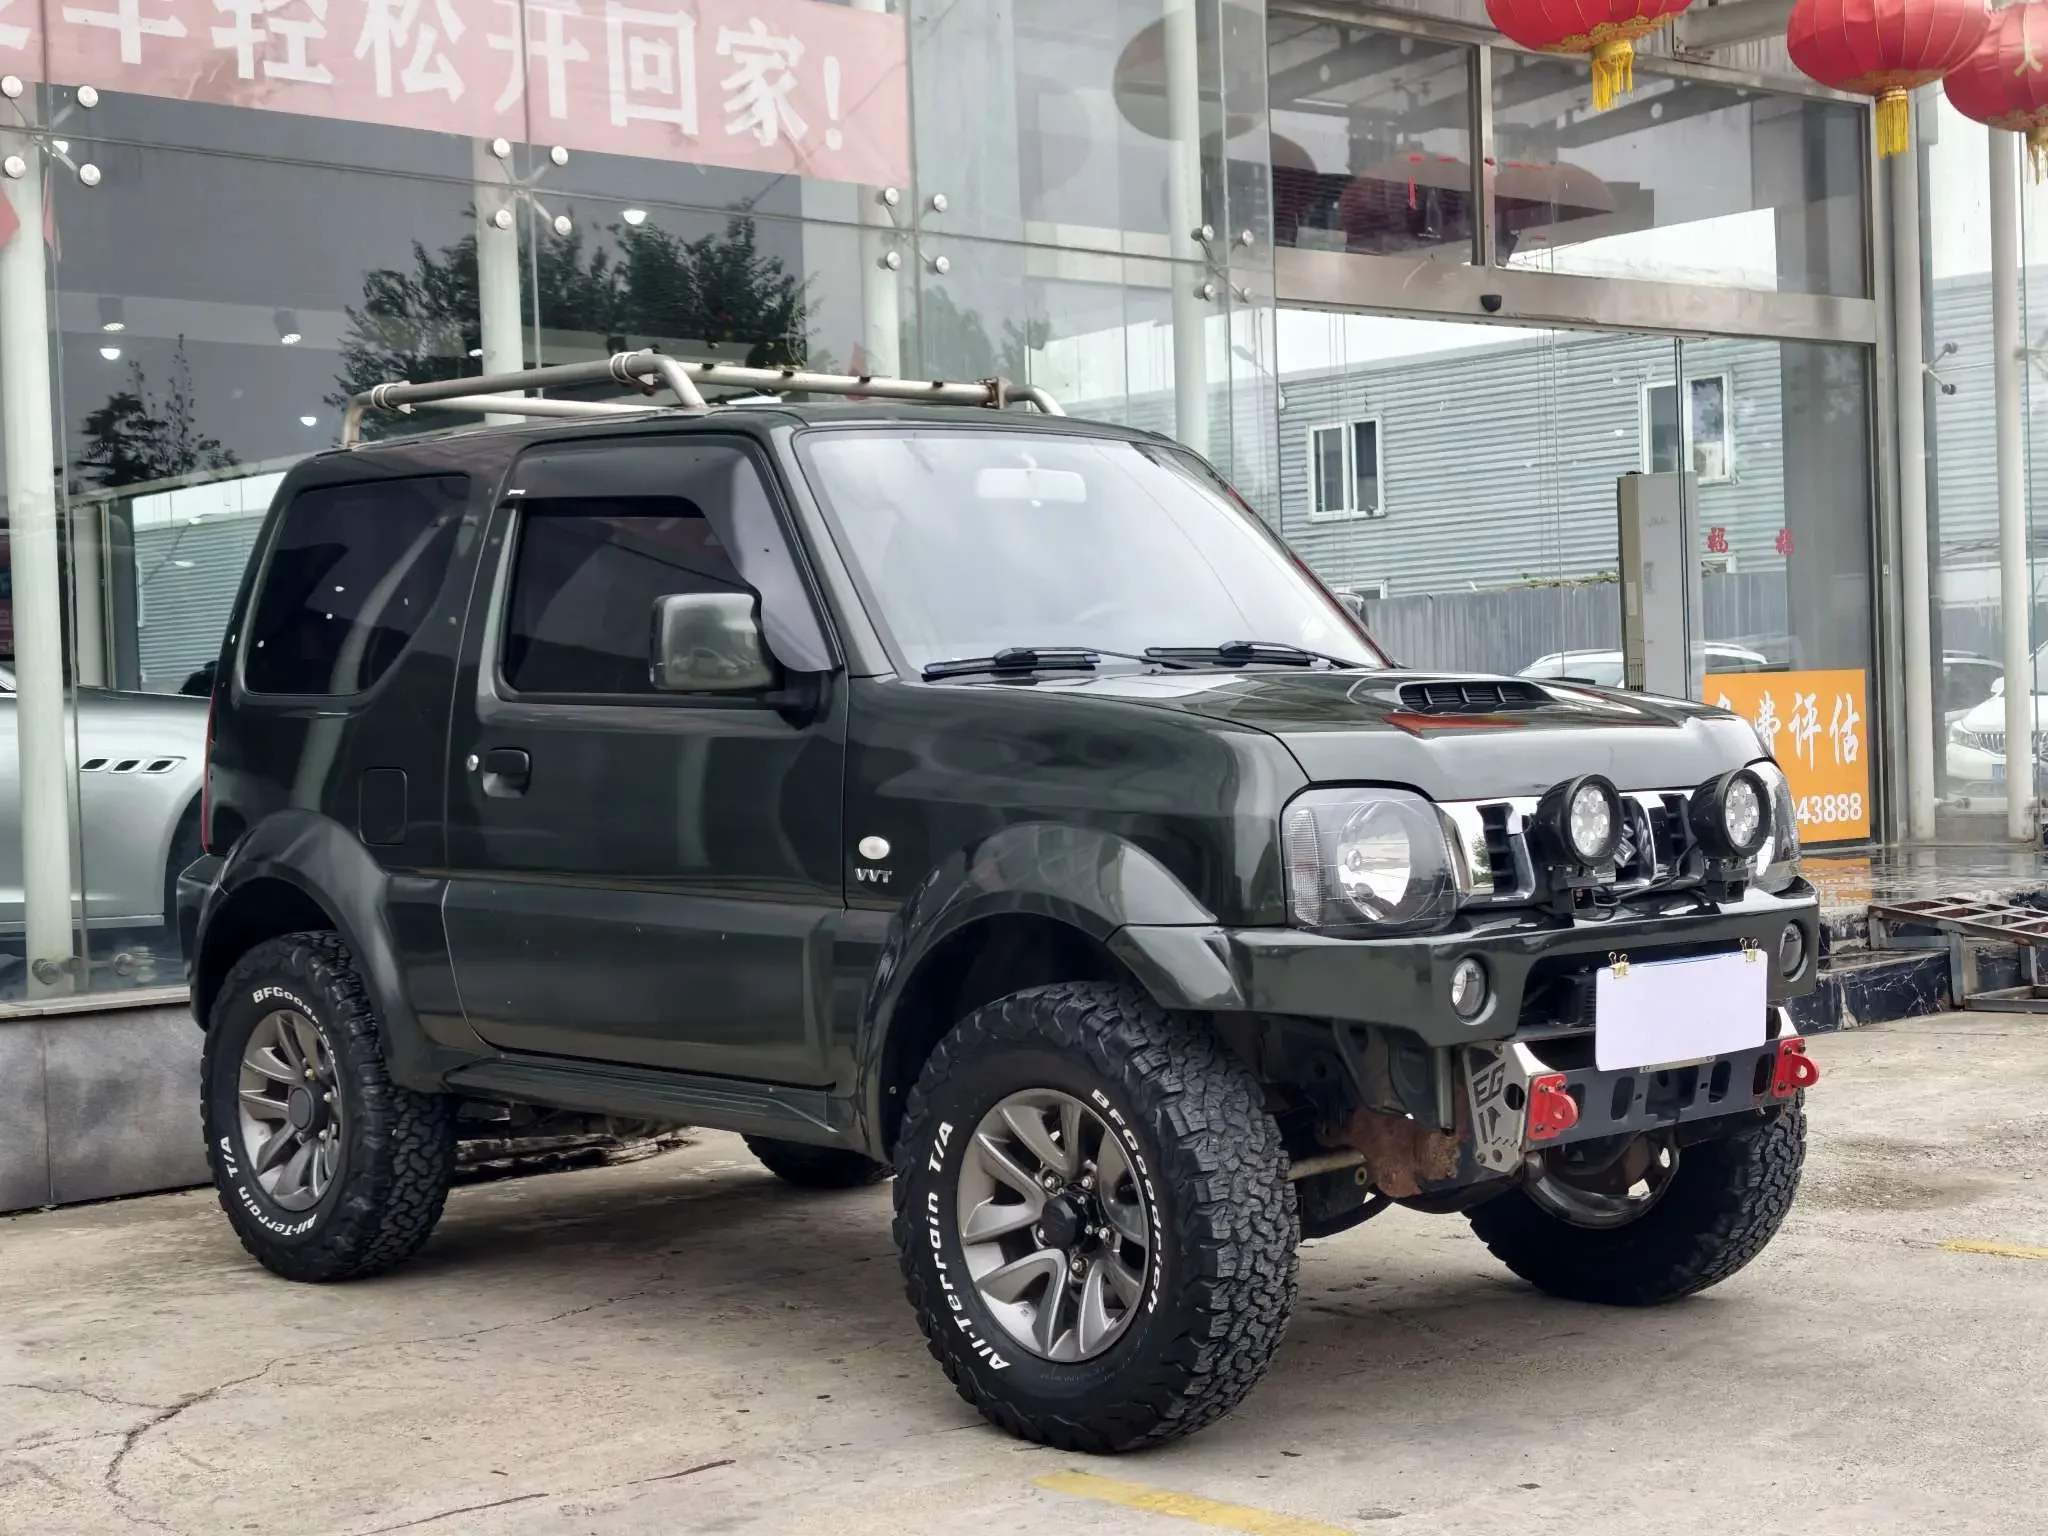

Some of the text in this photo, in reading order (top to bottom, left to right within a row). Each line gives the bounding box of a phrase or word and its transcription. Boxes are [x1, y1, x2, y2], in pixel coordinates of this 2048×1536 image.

[1717, 689, 1861, 773] 费评估
[1792, 792, 1863, 825] 43888
[854, 867, 893, 884] VVT
[220, 1136, 239, 1178] T/A
[1090, 1088, 1163, 1314] BFGoodrich
[926, 1120, 1011, 1371] All-Terrain T/A
